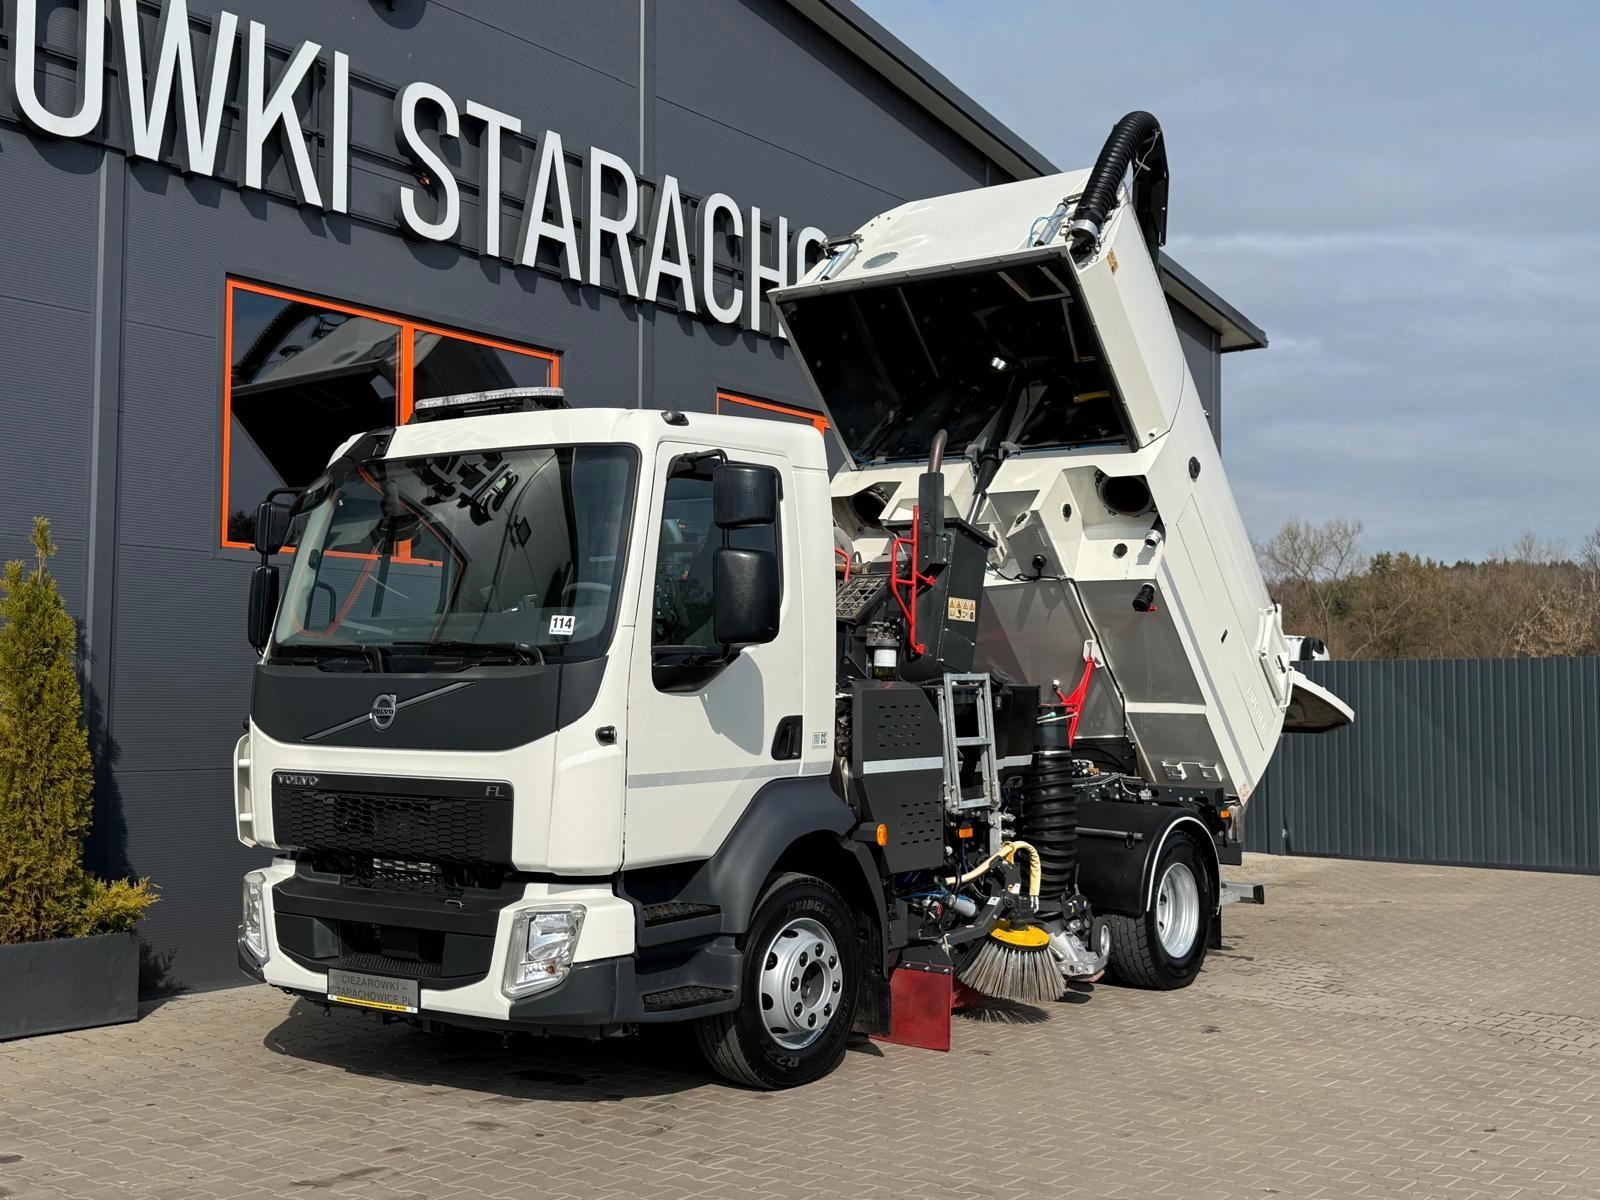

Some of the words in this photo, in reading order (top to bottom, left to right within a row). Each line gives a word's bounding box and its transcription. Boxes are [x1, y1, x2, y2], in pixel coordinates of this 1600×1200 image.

[553, 617, 572, 629] 114
[275, 774, 319, 786] VOLVO
[485, 785, 505, 796] FL
